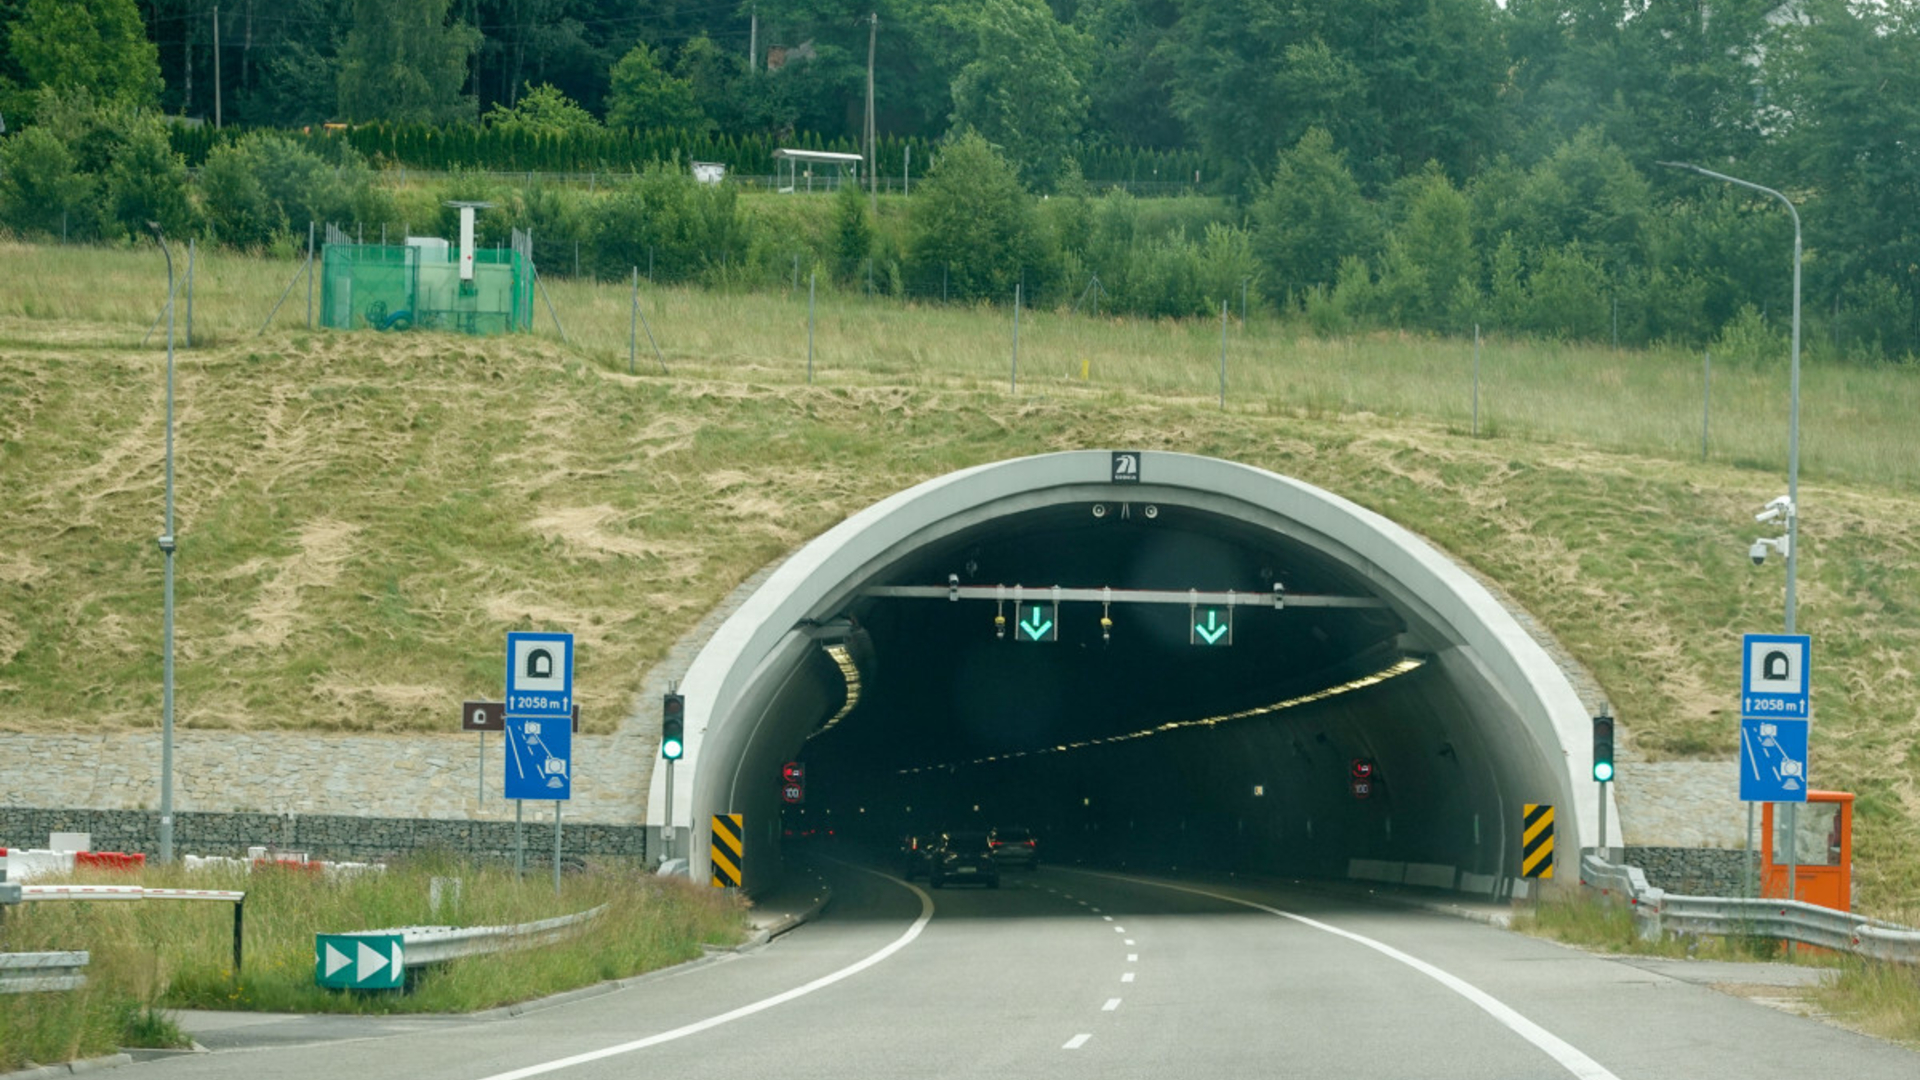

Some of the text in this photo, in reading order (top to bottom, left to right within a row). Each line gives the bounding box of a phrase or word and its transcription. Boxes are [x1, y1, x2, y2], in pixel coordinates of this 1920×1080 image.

[518, 697, 560, 709] 2058 m
[1754, 699, 1797, 711] 2058 m
[785, 787, 799, 798] 100
